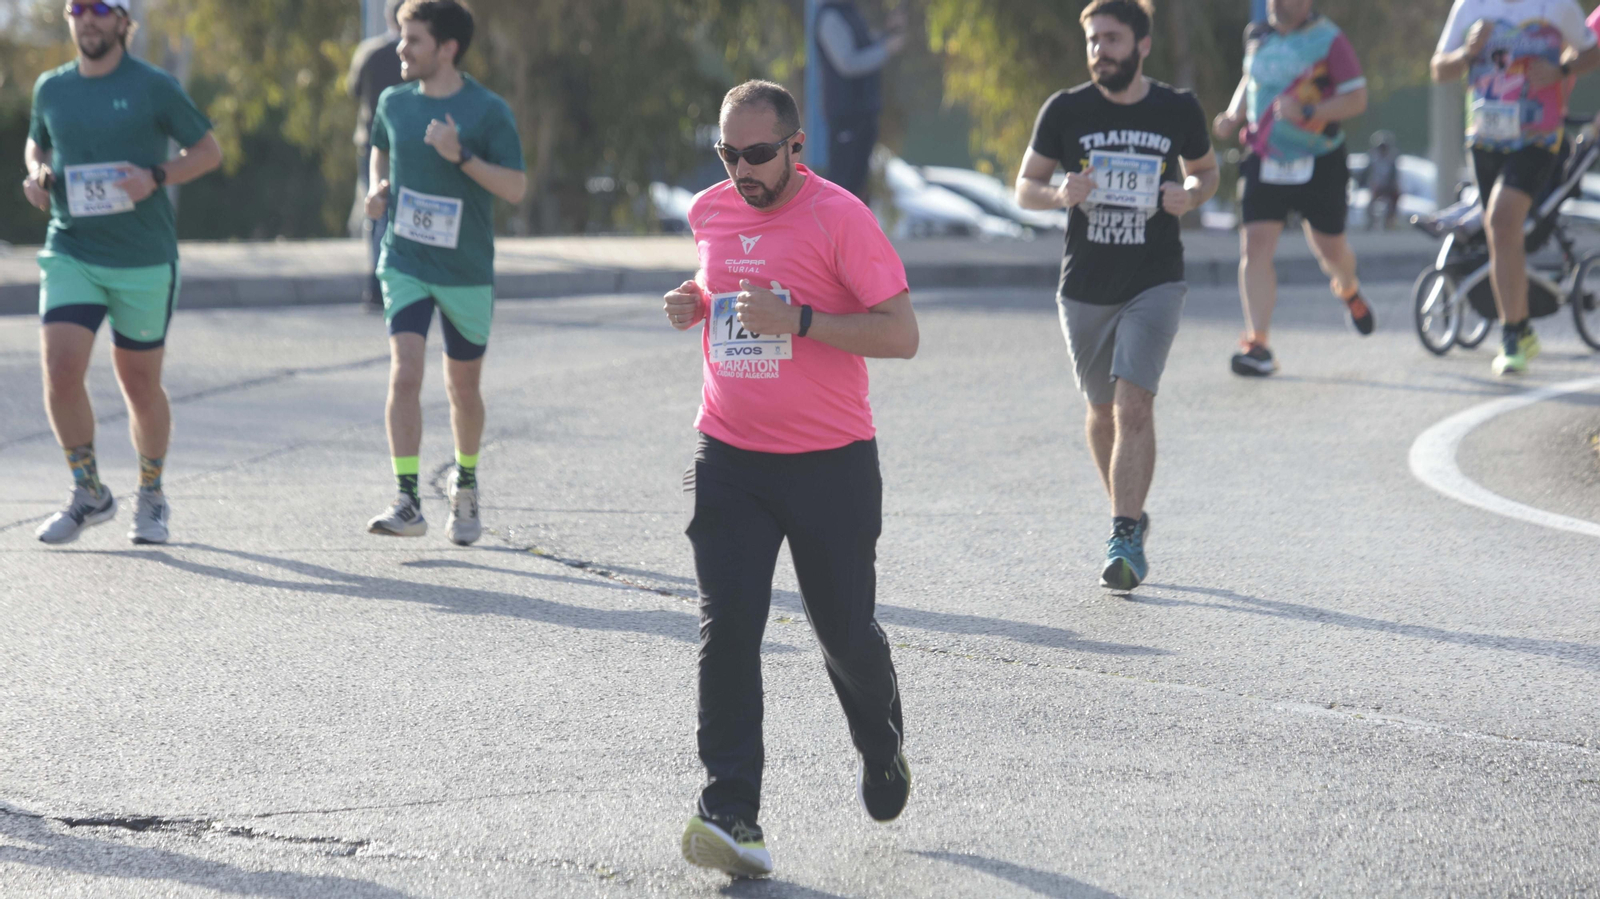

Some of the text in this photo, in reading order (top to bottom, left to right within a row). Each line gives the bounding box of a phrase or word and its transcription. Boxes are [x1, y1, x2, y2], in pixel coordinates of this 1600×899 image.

[1106, 170, 1138, 190] 118
[84, 180, 105, 201] 55
[413, 209, 432, 230] 66
[1088, 211, 1146, 228] SUPER
[1087, 225, 1146, 244] SAIYAN
[725, 346, 763, 356] EVOS
